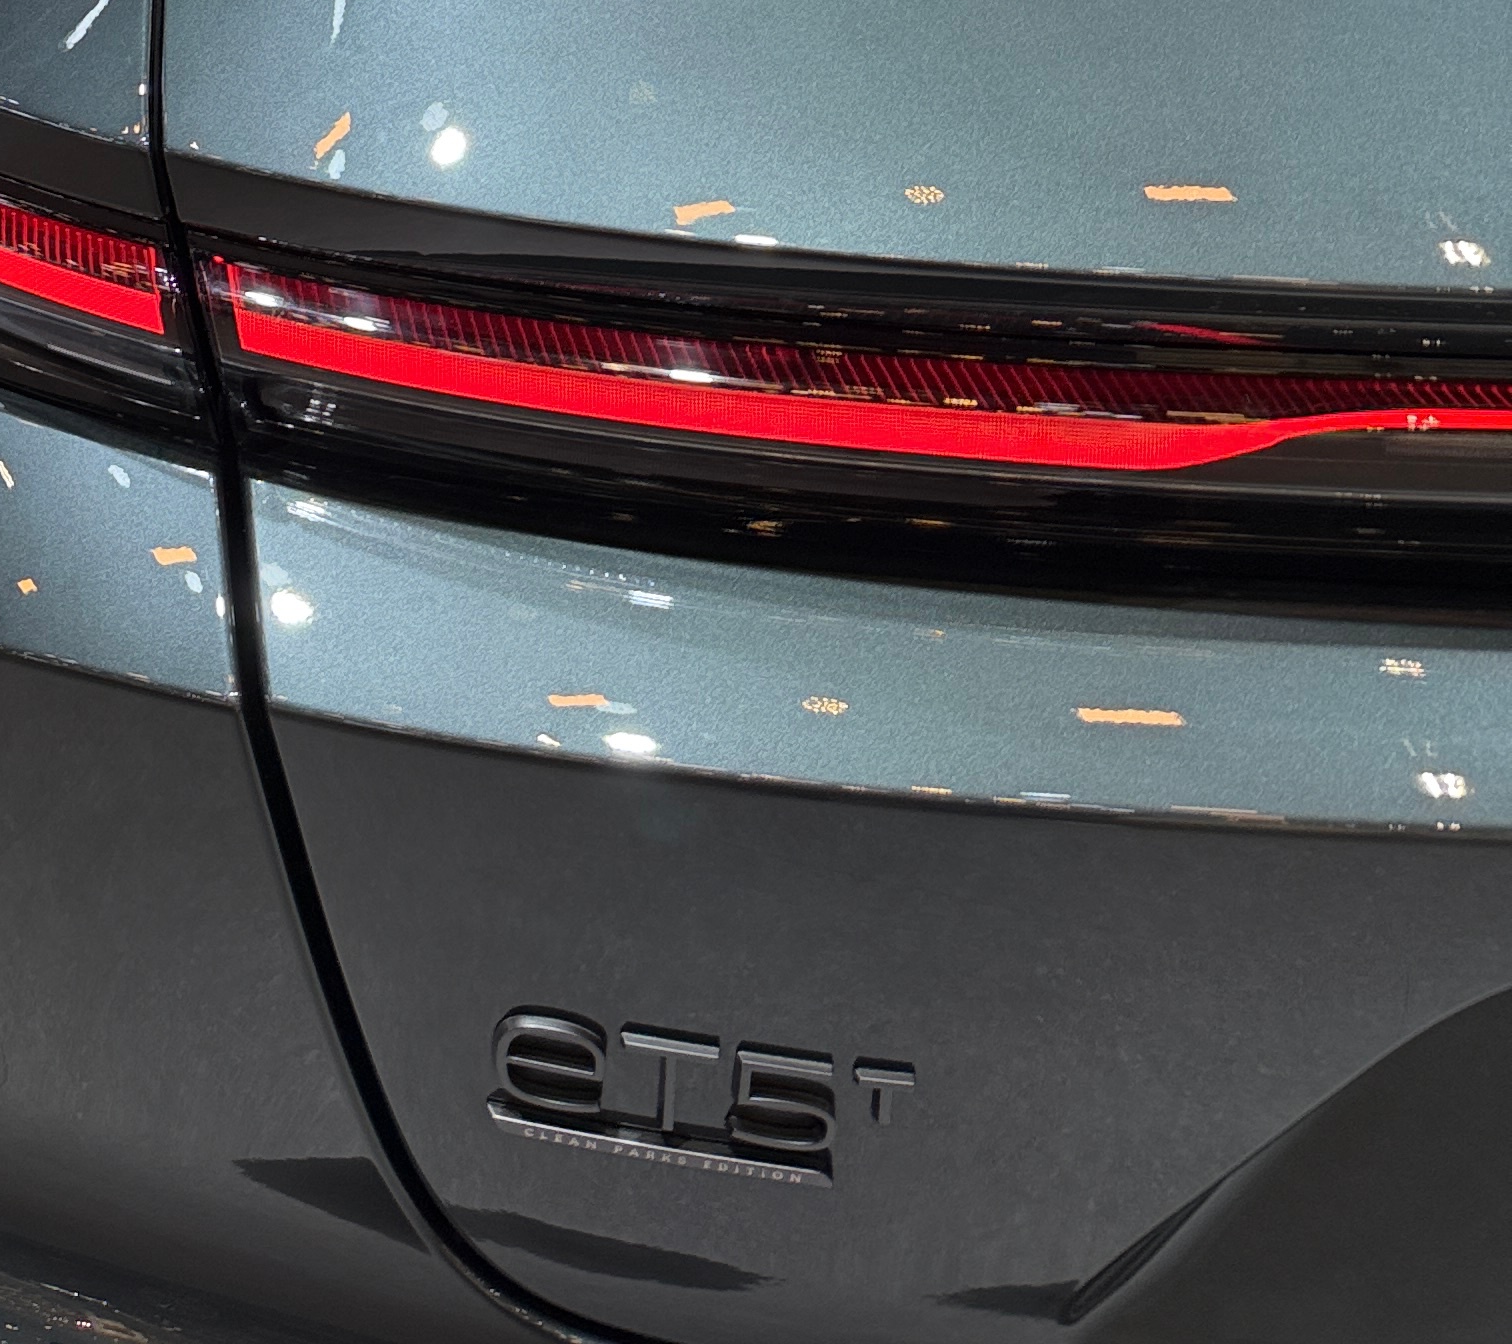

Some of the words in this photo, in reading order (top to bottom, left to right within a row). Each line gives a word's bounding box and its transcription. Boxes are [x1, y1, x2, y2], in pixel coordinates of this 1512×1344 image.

[523, 1126, 598, 1151] CLEAN
[612, 1144, 688, 1166] PARKS
[702, 1159, 803, 1185] EDITION
